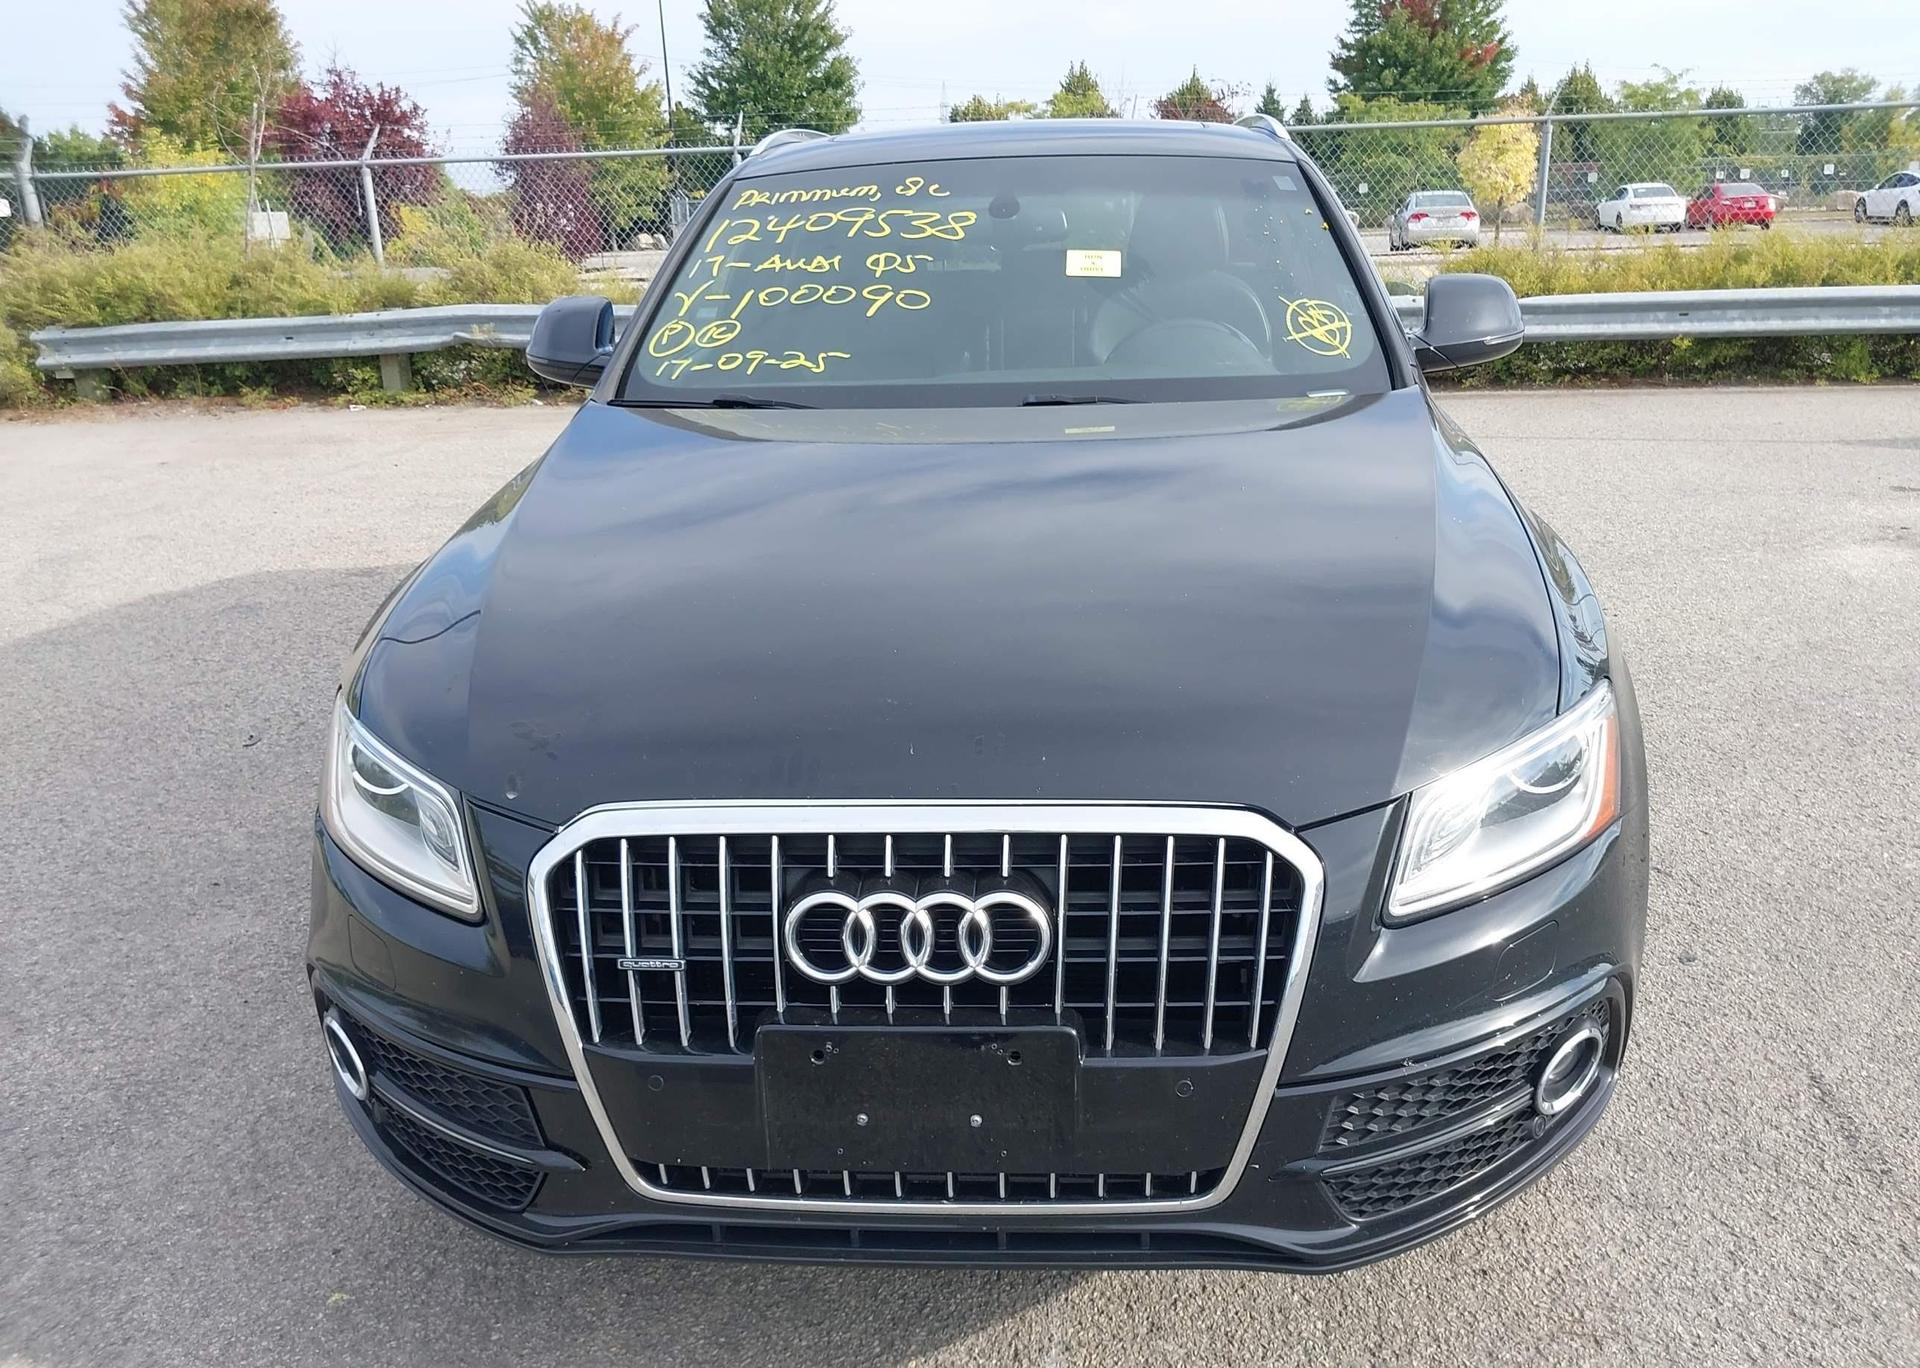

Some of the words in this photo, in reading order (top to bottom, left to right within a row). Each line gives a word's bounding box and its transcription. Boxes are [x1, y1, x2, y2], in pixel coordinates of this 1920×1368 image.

[705, 207, 978, 253] 12409538
[655, 349, 852, 380] 17-09-25
[622, 961, 679, 969] quattro
